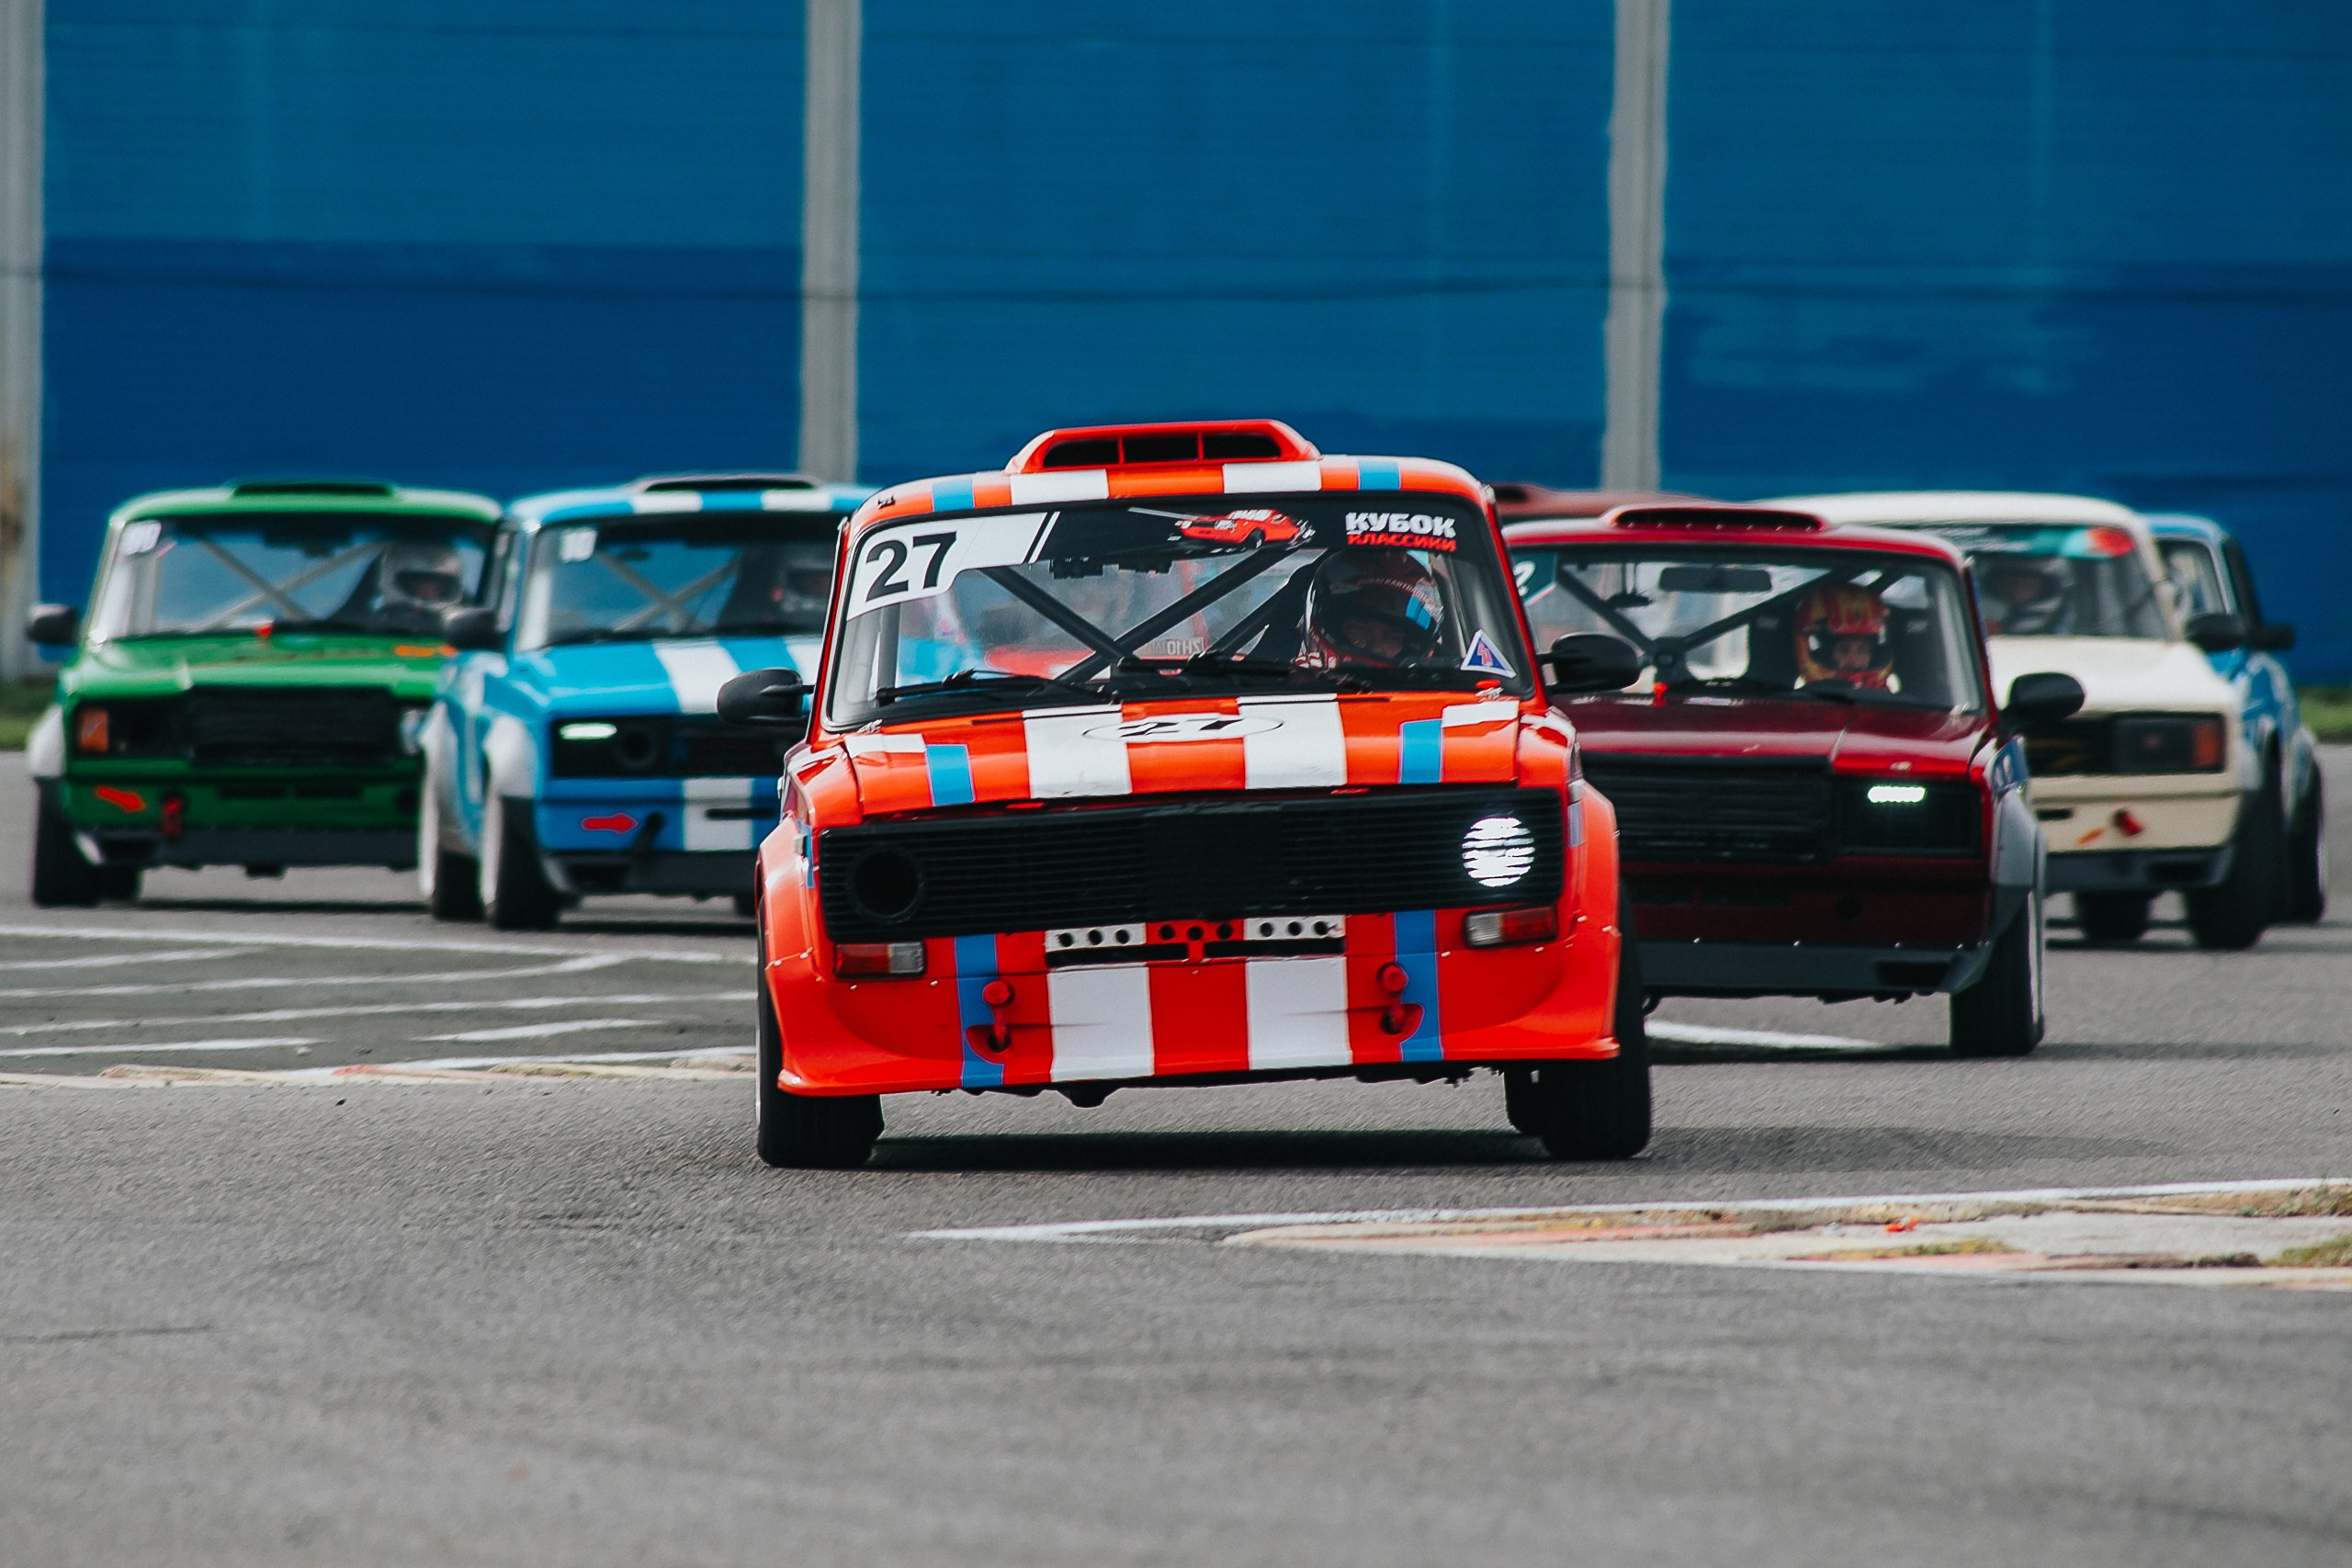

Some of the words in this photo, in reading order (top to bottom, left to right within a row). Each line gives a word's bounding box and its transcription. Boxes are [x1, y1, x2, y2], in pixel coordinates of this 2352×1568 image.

[1345, 513, 1456, 538] КУБОК
[1347, 532, 1457, 552] КЛАССИКИ
[865, 531, 957, 603] 27
[1117, 717, 1246, 739] 27
